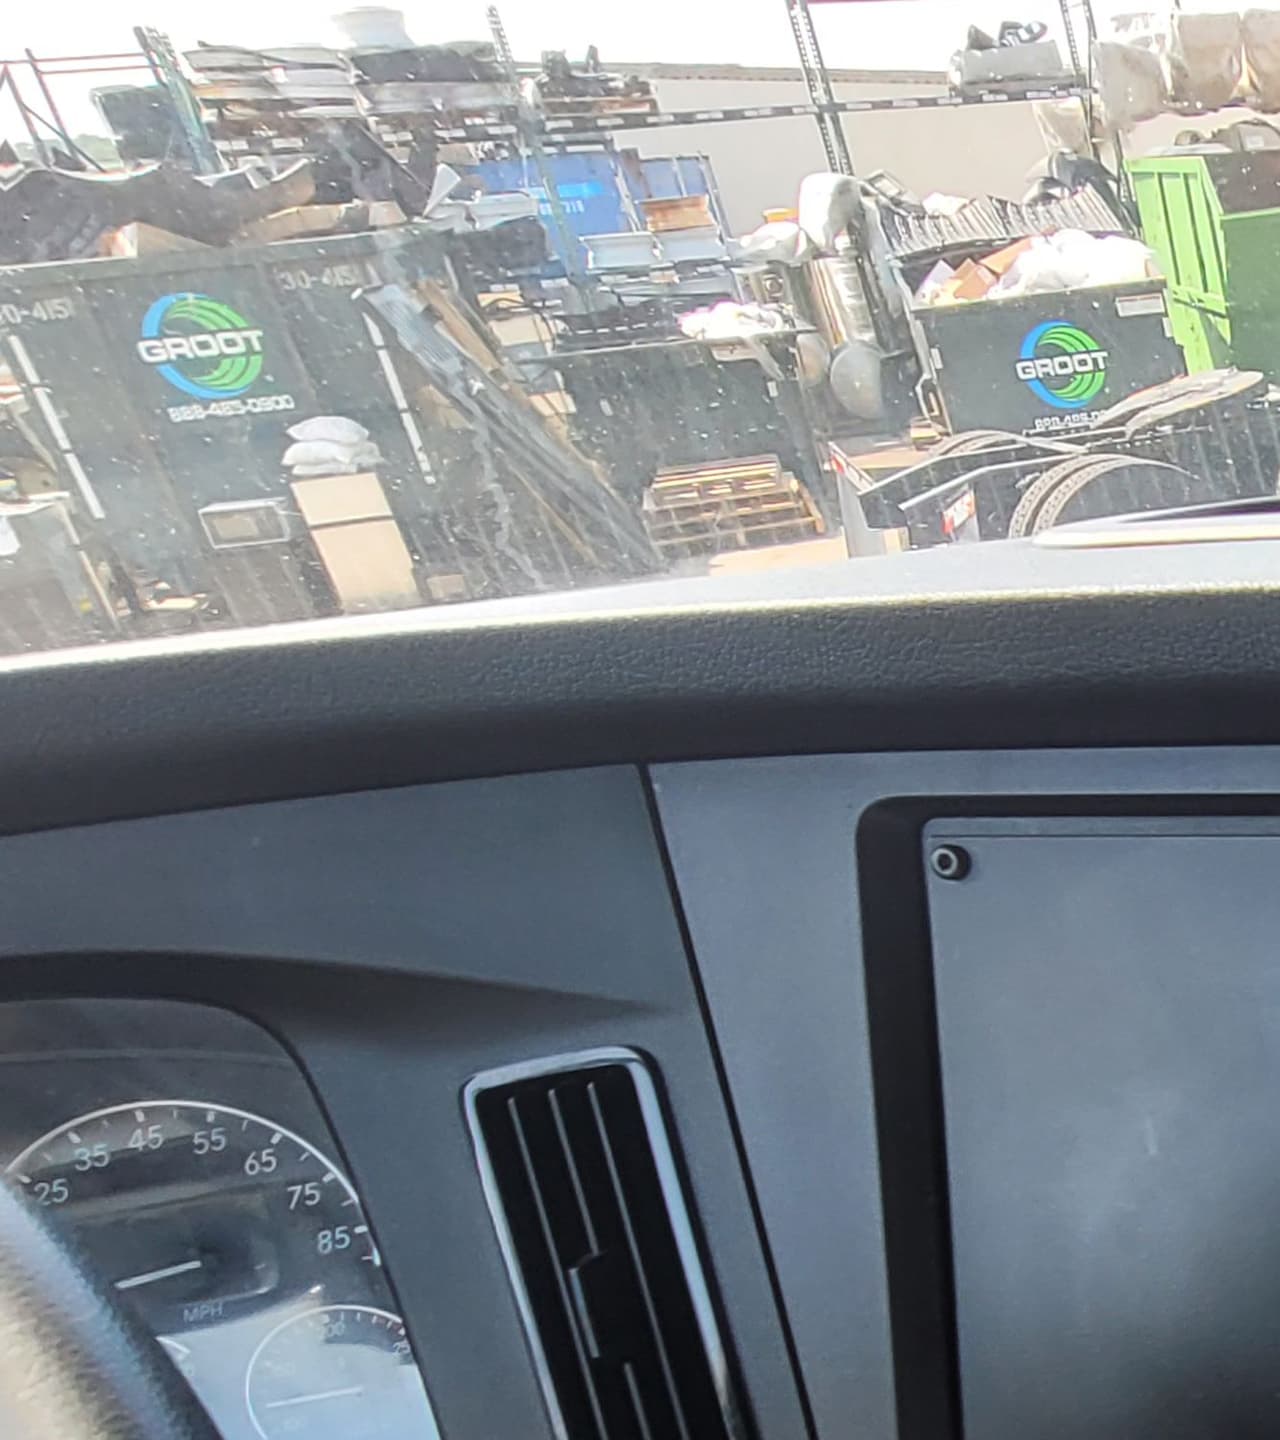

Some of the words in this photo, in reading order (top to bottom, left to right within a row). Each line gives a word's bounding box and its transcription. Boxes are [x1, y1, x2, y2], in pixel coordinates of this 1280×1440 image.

[136, 329, 264, 364] GROOT
[1015, 351, 1109, 381] GROOT
[128, 1124, 164, 1151] 45
[192, 1128, 227, 1155] 55
[74, 1144, 111, 1172] 35
[244, 1148, 278, 1175] 65
[34, 1178, 70, 1206] 25
[287, 1181, 321, 1210] 75
[317, 1226, 351, 1254] 85
[183, 1302, 224, 1323] MPH
